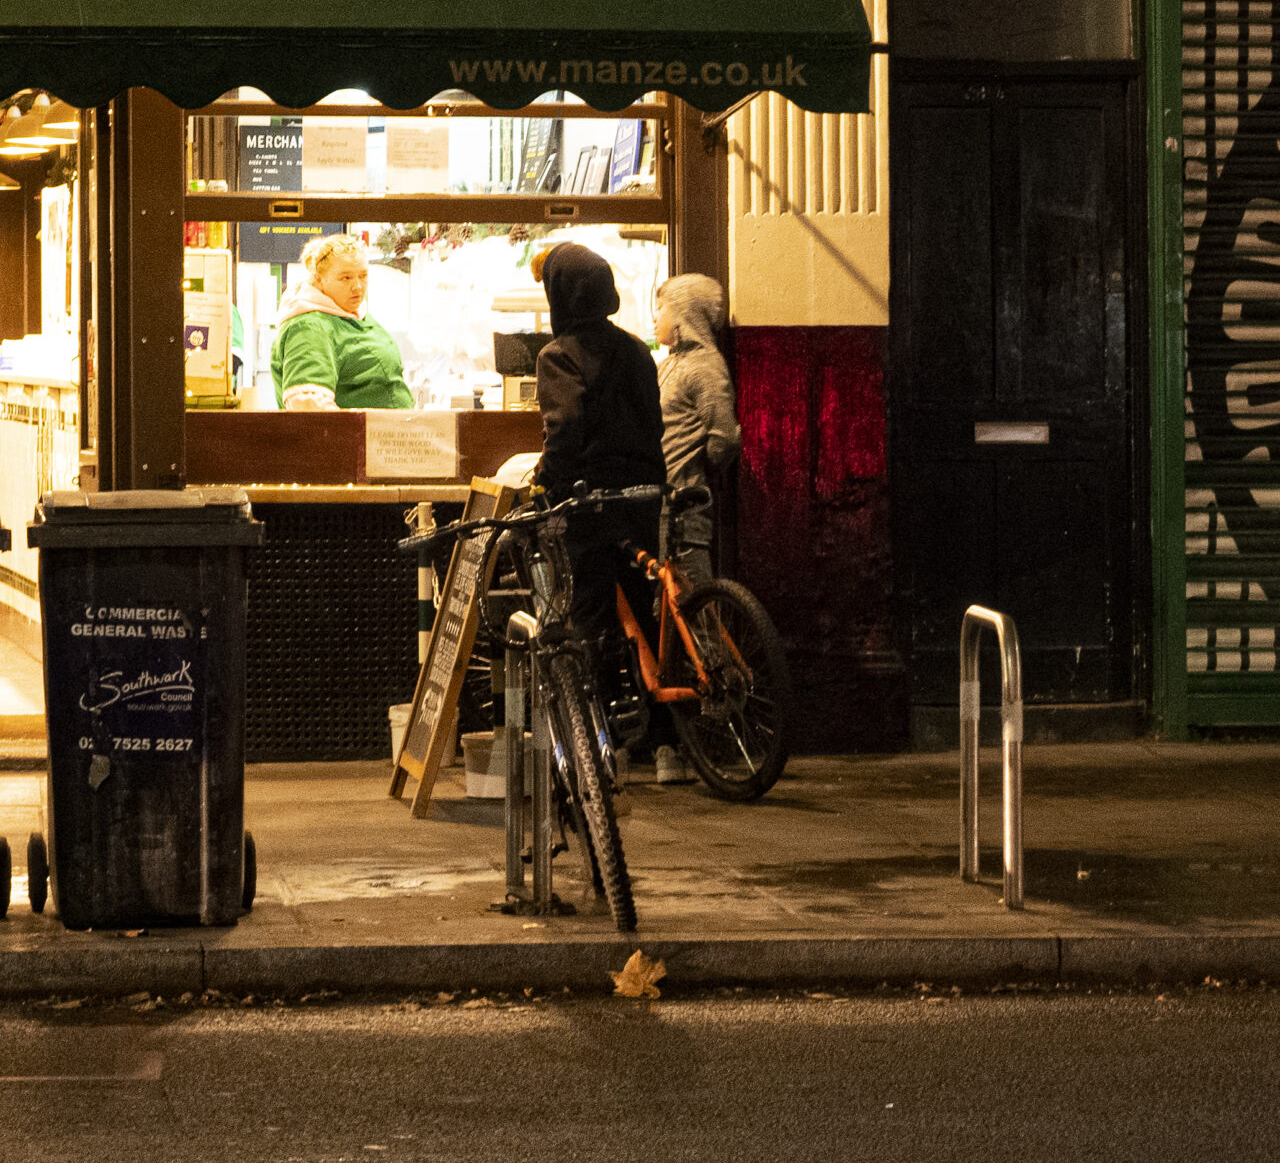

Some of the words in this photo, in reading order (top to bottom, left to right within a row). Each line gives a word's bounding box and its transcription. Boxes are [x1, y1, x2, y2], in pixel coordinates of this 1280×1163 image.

[448, 55, 809, 87] www.manze.co.uk
[71, 623, 147, 638] GENERAL
[151, 625, 209, 640] WASE
[79, 660, 193, 712] Southwark
[160, 692, 193, 702] Council
[112, 738, 152, 752] 7525
[155, 738, 194, 752] 2627
